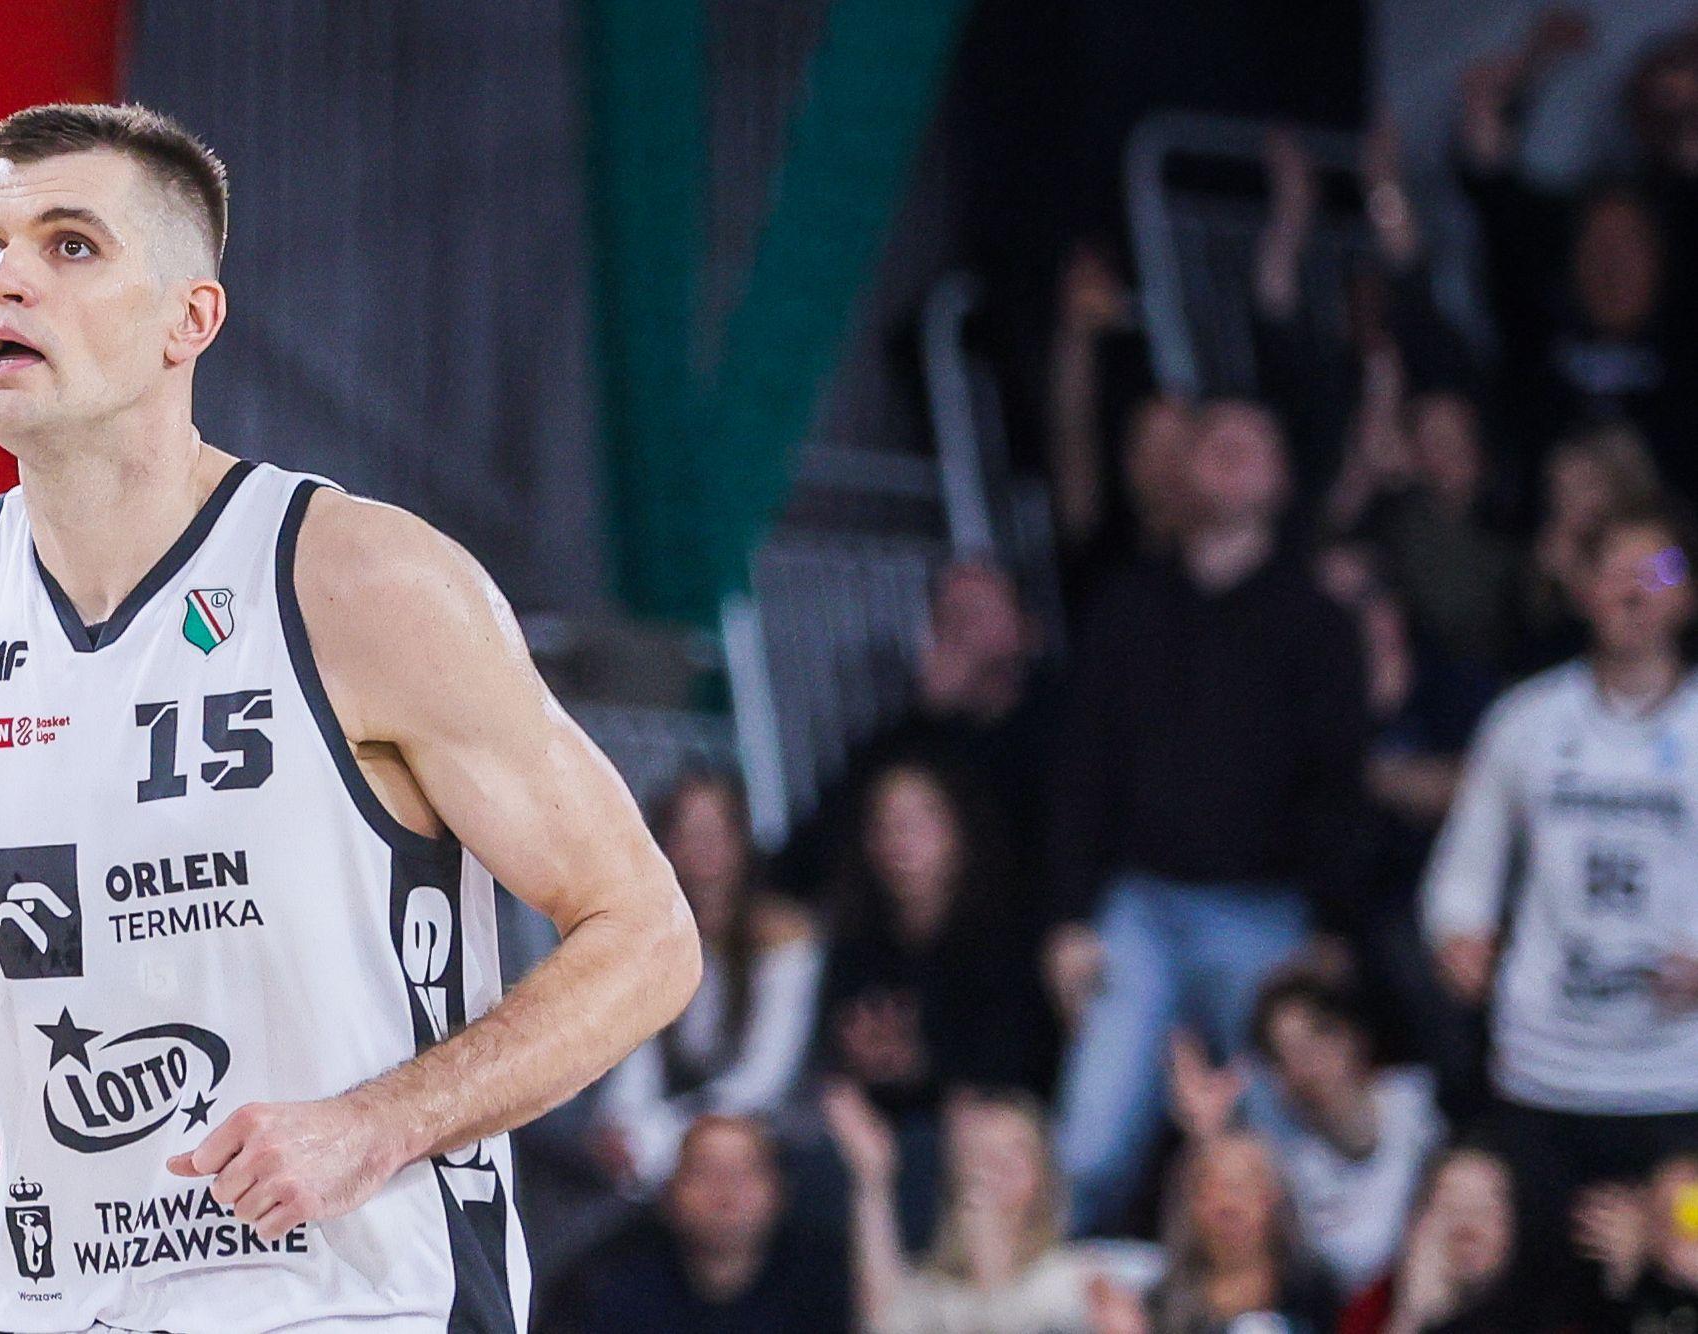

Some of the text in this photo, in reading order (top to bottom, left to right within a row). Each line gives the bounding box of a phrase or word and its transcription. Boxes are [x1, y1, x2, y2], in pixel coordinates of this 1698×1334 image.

[36, 715, 71, 728] Basket
[36, 730, 56, 745] Liga
[135, 688, 274, 804] 15
[105, 850, 249, 902] ORLEN
[108, 898, 265, 943] TERMIKA
[64, 1046, 187, 1128] LOTTO
[94, 1186, 235, 1235] TRMWA
